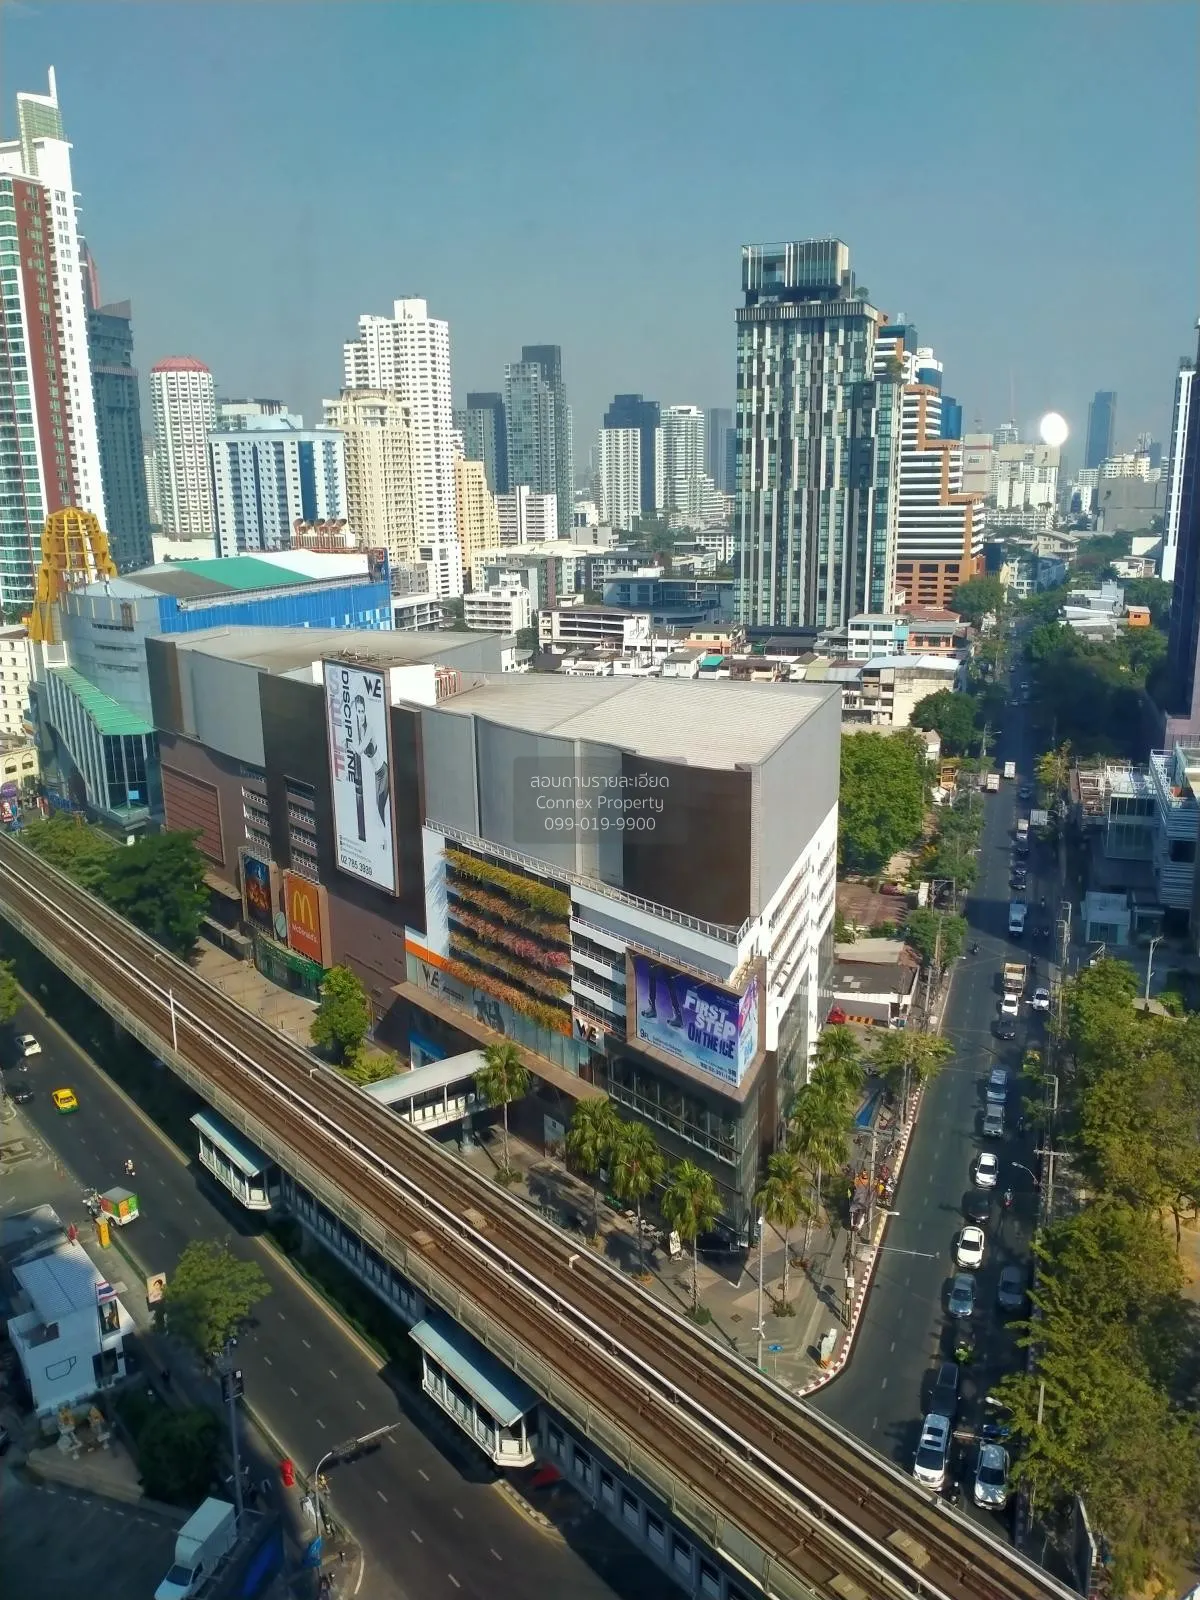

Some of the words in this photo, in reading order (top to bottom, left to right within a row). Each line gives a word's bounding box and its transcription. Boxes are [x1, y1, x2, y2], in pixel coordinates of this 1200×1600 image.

[363, 675, 382, 698] WE
[341, 670, 356, 783] DISCIPLINE
[421, 963, 440, 988] WE
[683, 990, 729, 1024] FIRST
[687, 1022, 701, 1045] ON
[702, 1031, 719, 1053] THE
[719, 1040, 736, 1060] ICE
[695, 1012, 737, 1041] STEP
